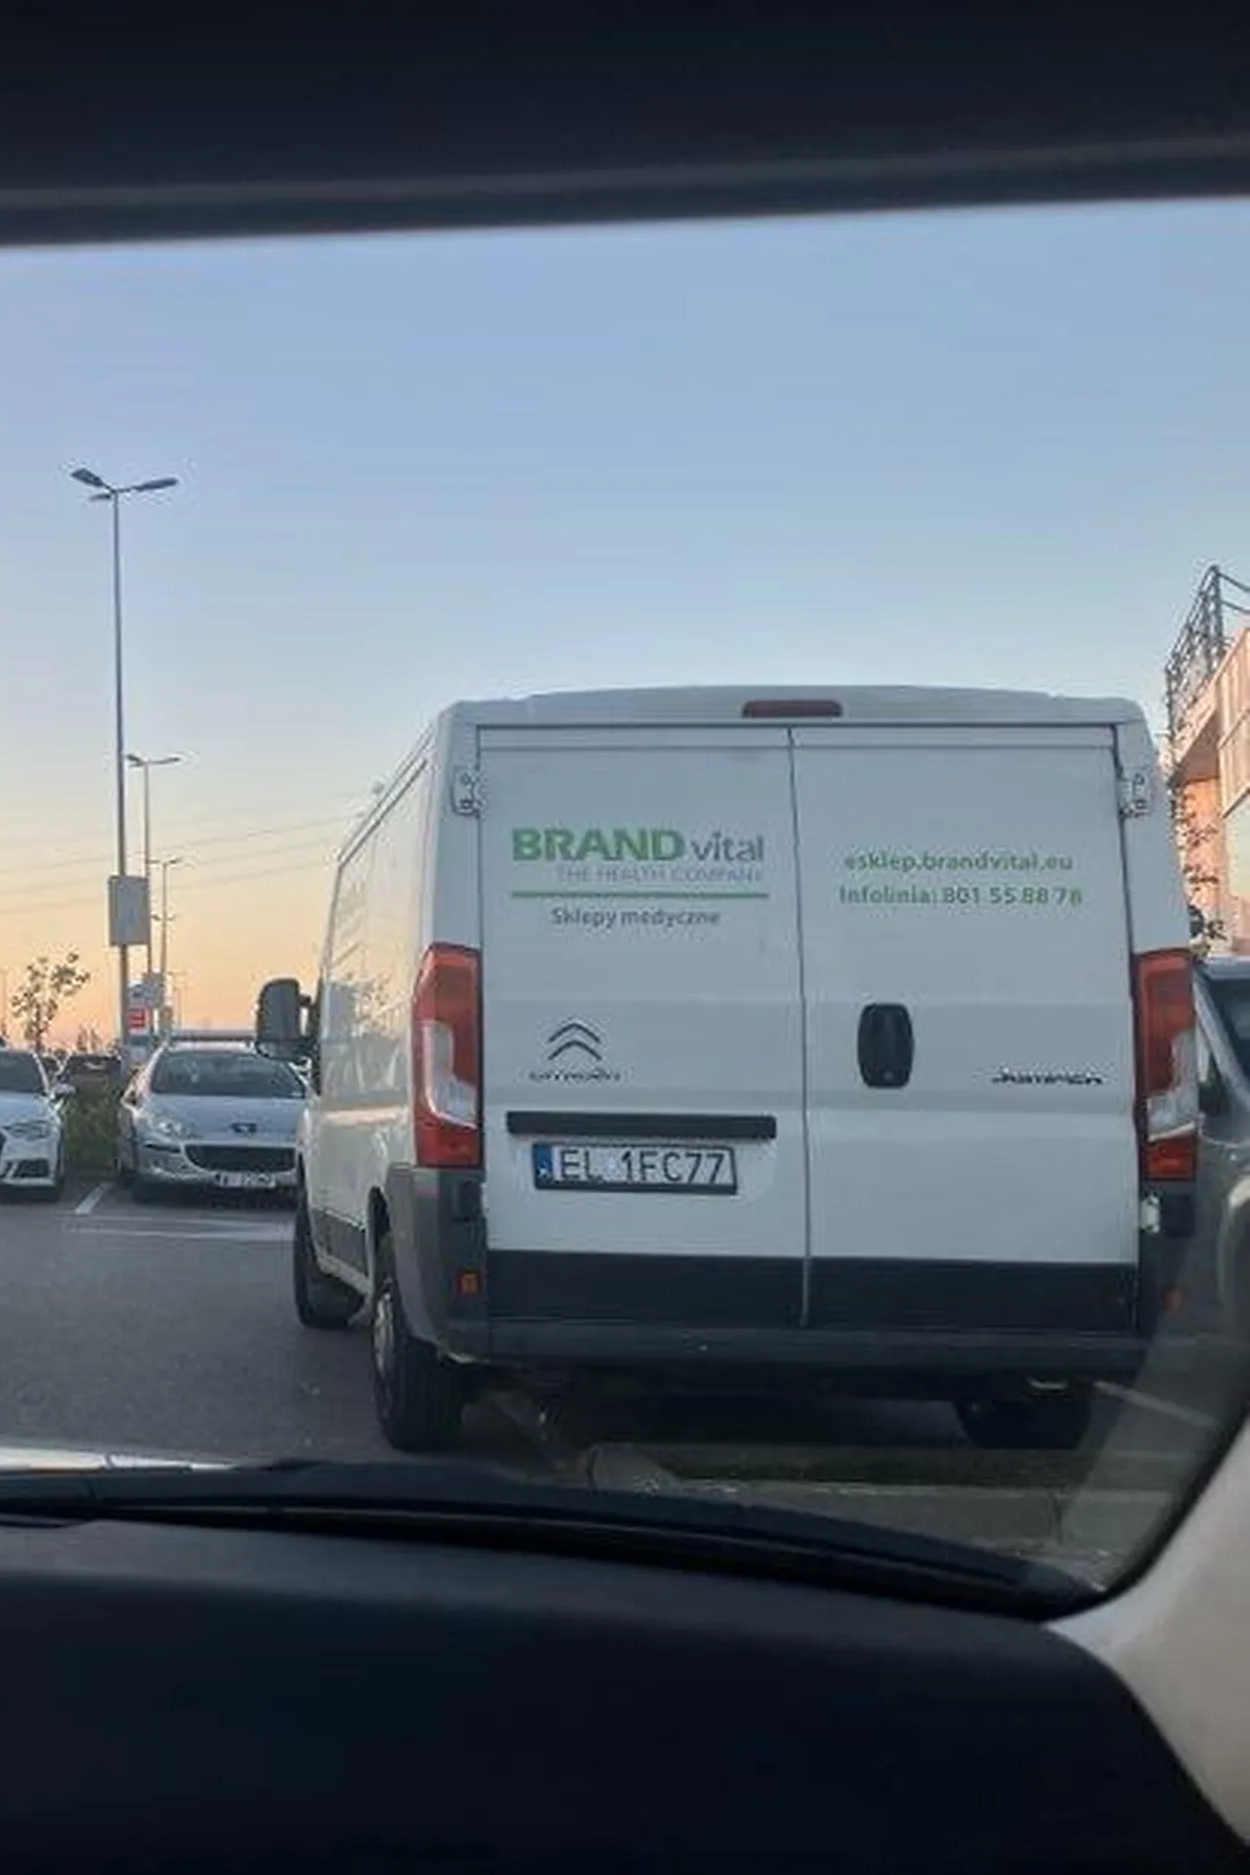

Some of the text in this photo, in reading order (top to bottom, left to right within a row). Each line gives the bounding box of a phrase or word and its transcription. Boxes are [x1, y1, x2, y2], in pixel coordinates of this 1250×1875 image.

[511, 827, 765, 863] BRAND vital
[839, 883, 936, 905] Infolinia:
[942, 885, 981, 906] 801
[989, 886, 1017, 906] 55
[1021, 886, 1049, 906] 88
[550, 906, 721, 929] Sklepy medyczne
[559, 1149, 726, 1185] EL 1FC77
